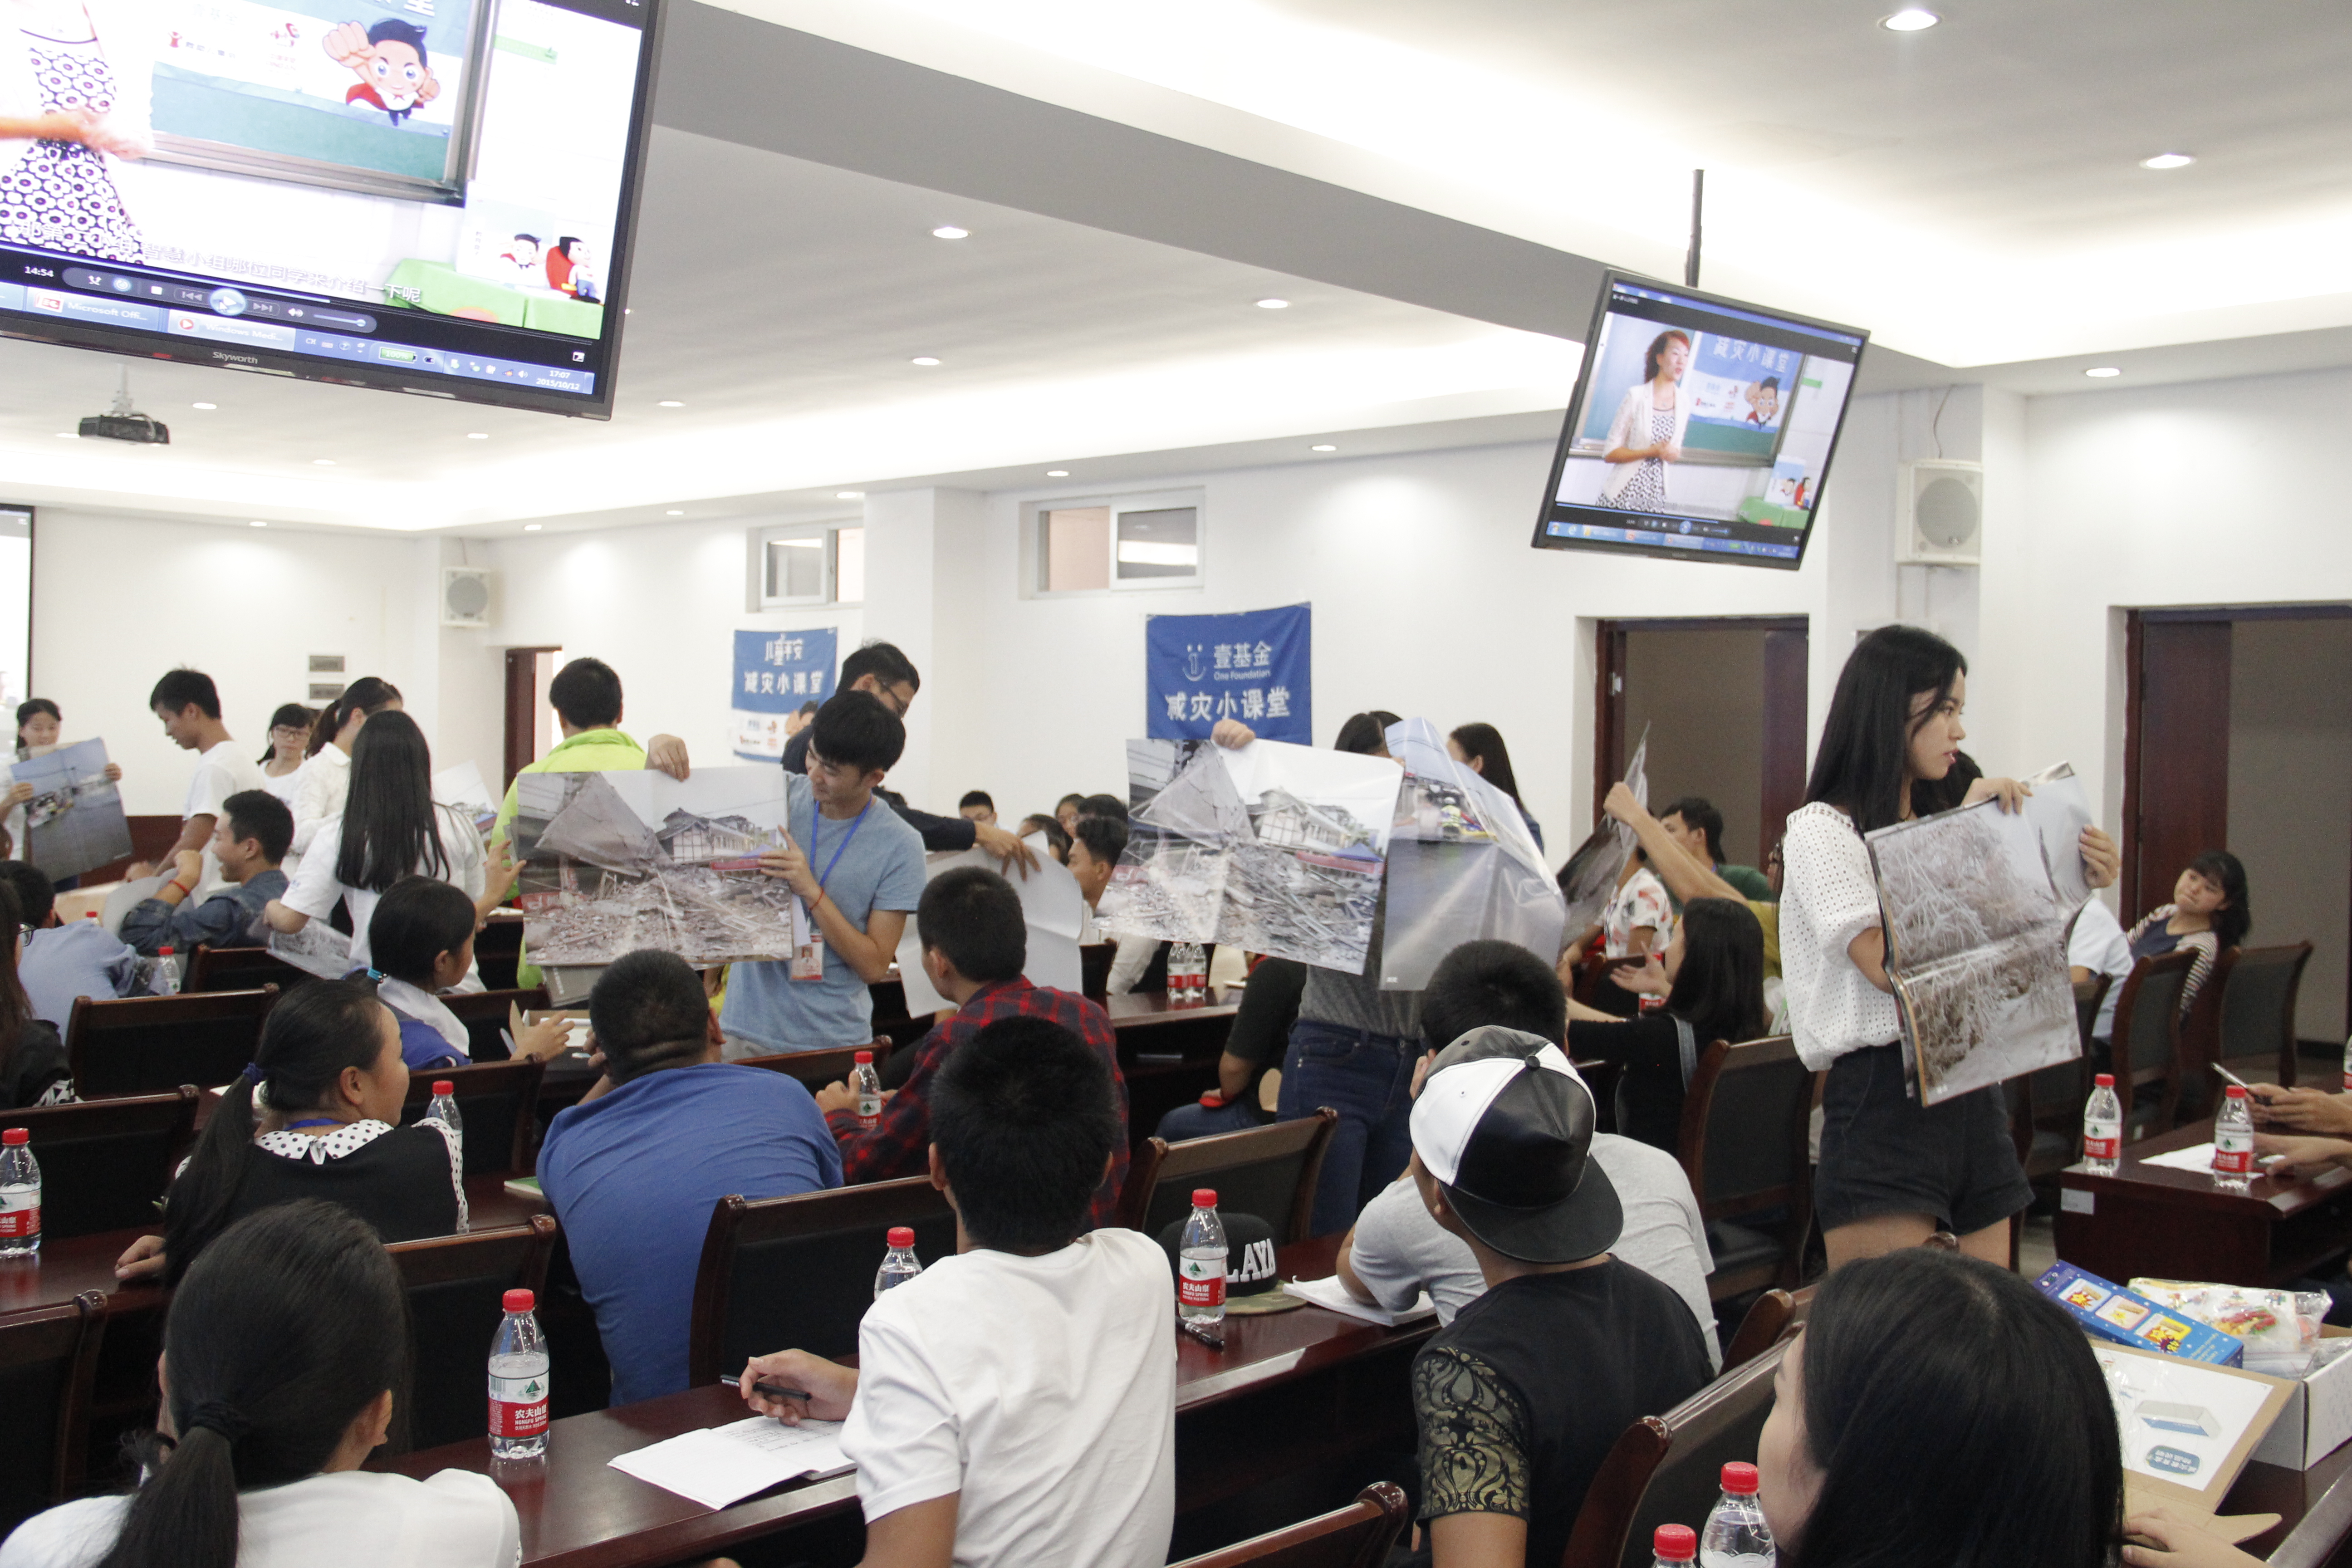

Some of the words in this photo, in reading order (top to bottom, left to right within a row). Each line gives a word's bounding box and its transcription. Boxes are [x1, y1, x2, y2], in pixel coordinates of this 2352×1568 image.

[24, 266, 54, 278] 14:54
[141, 240, 421, 303] 智慧小组哪位同学来介绍一下呢
[68, 302, 119, 317] Microsoft
[205, 323, 249, 336] Windows
[213, 351, 258, 364] Skyworth
[386, 351, 409, 360] 100%
[549, 370, 571, 379] 17:07
[536, 378, 580, 390] 2015/10/12
[1214, 641, 1272, 669] 壹基金
[1214, 671, 1229, 681] One
[1230, 669, 1270, 680] Foundation
[1165, 686, 1290, 722] 减灾小课堂
[515, 1403, 547, 1419] 农夫山泉
